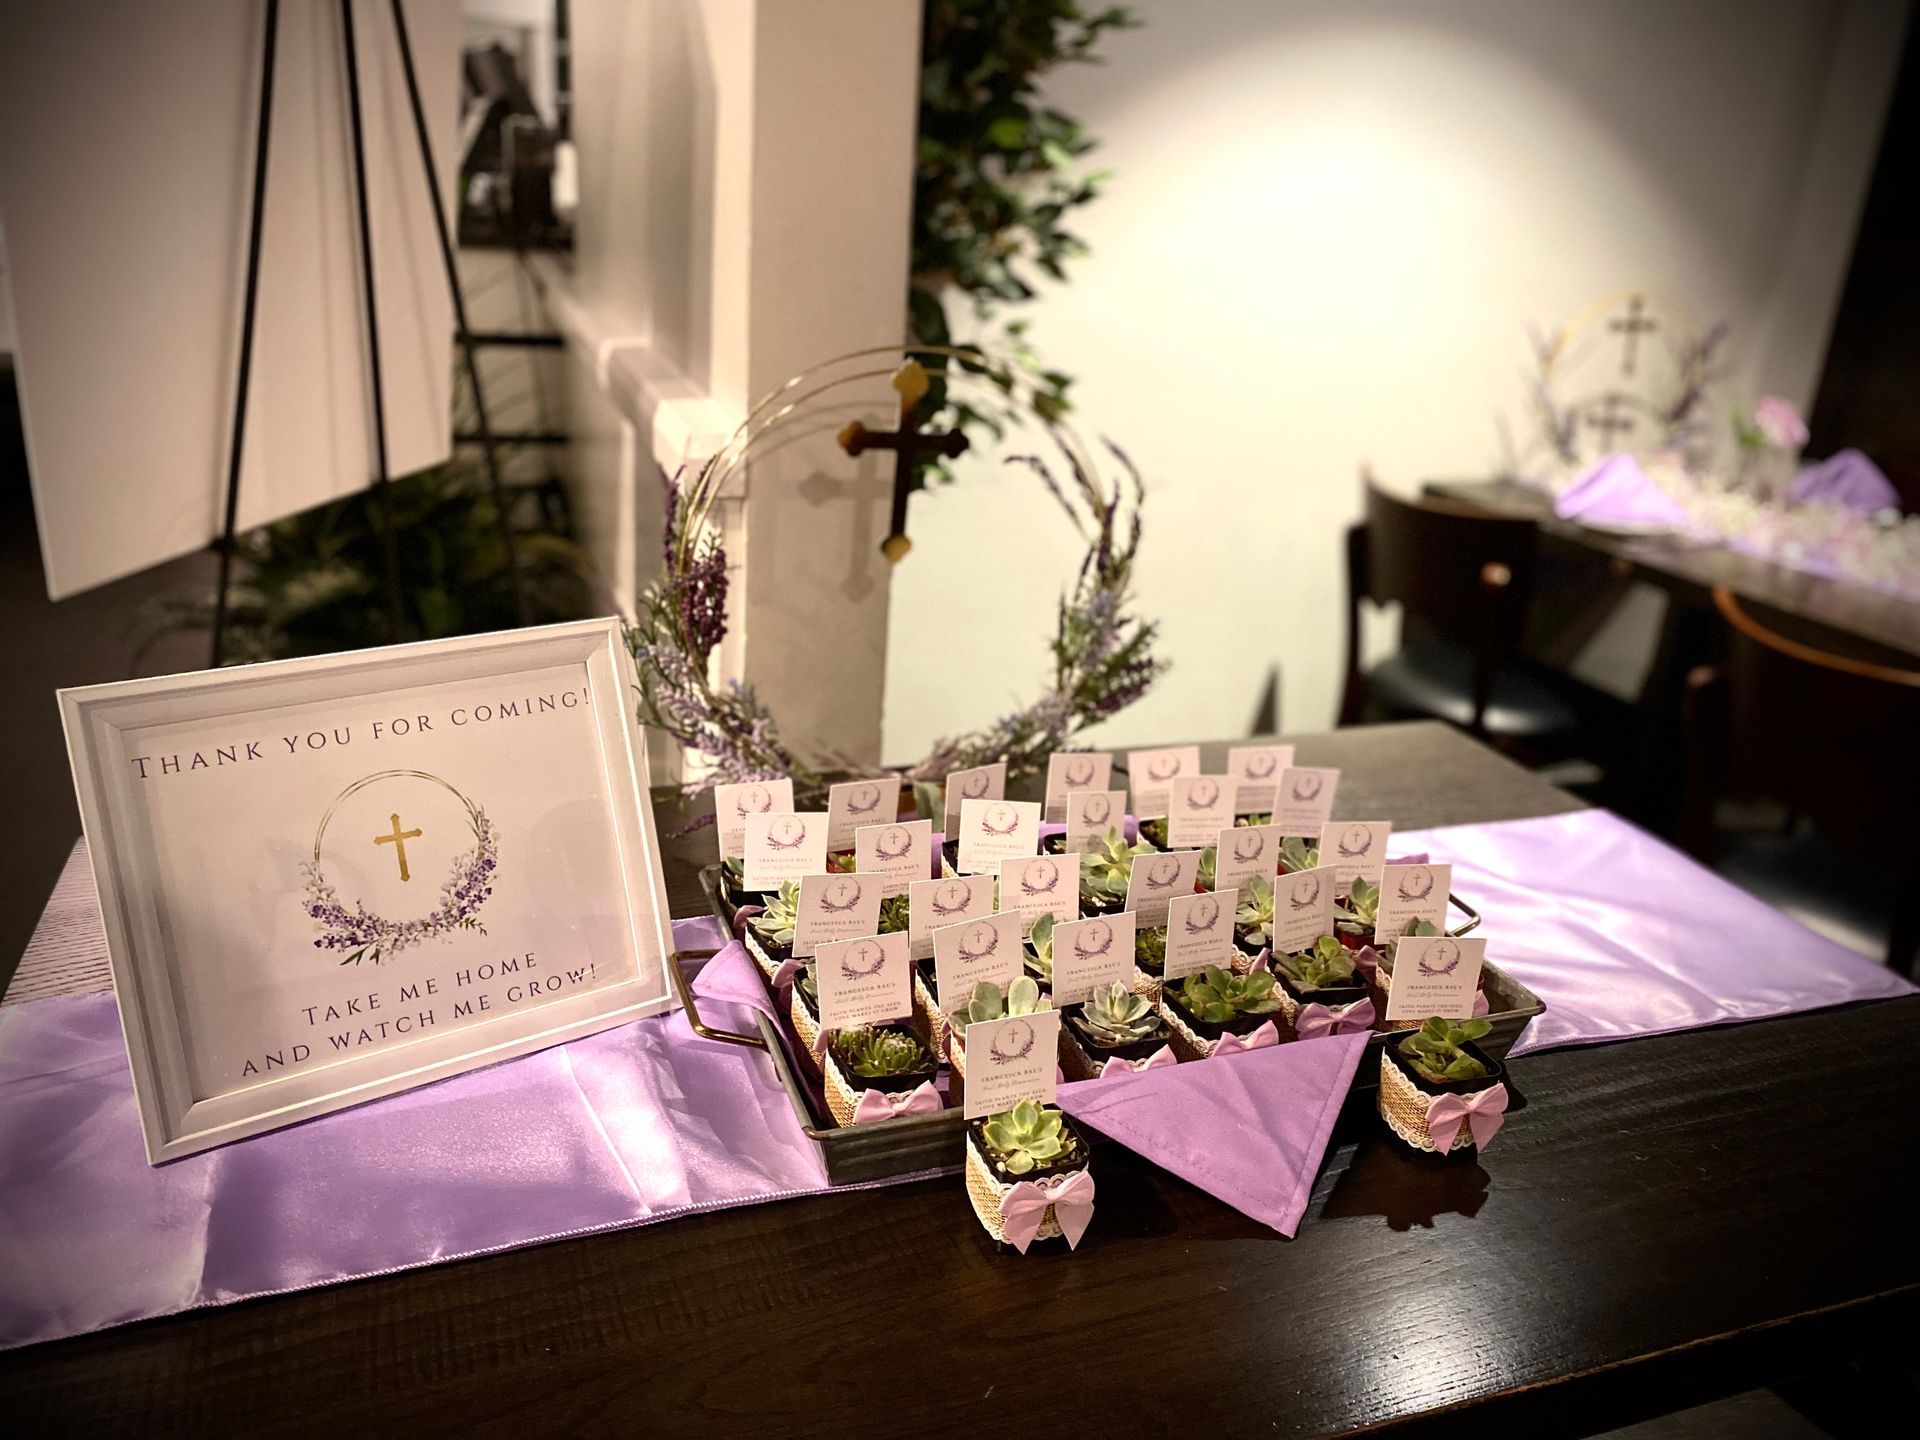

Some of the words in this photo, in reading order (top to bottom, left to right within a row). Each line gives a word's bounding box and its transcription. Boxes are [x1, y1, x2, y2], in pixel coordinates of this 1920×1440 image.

[131, 741, 263, 778] THANK
[283, 727, 351, 754] YOU
[372, 715, 434, 740] FOR
[450, 687, 590, 726] COMING!
[242, 1044, 311, 1077] AND
[328, 1010, 435, 1051] WATCH
[454, 994, 491, 1019] ME
[507, 963, 597, 1003] GROW!
[301, 993, 381, 1026] TAKE
[399, 978, 439, 1003] ME
[456, 952, 537, 987] HOME
[981, 1071, 1021, 1082] FRANCESCA
